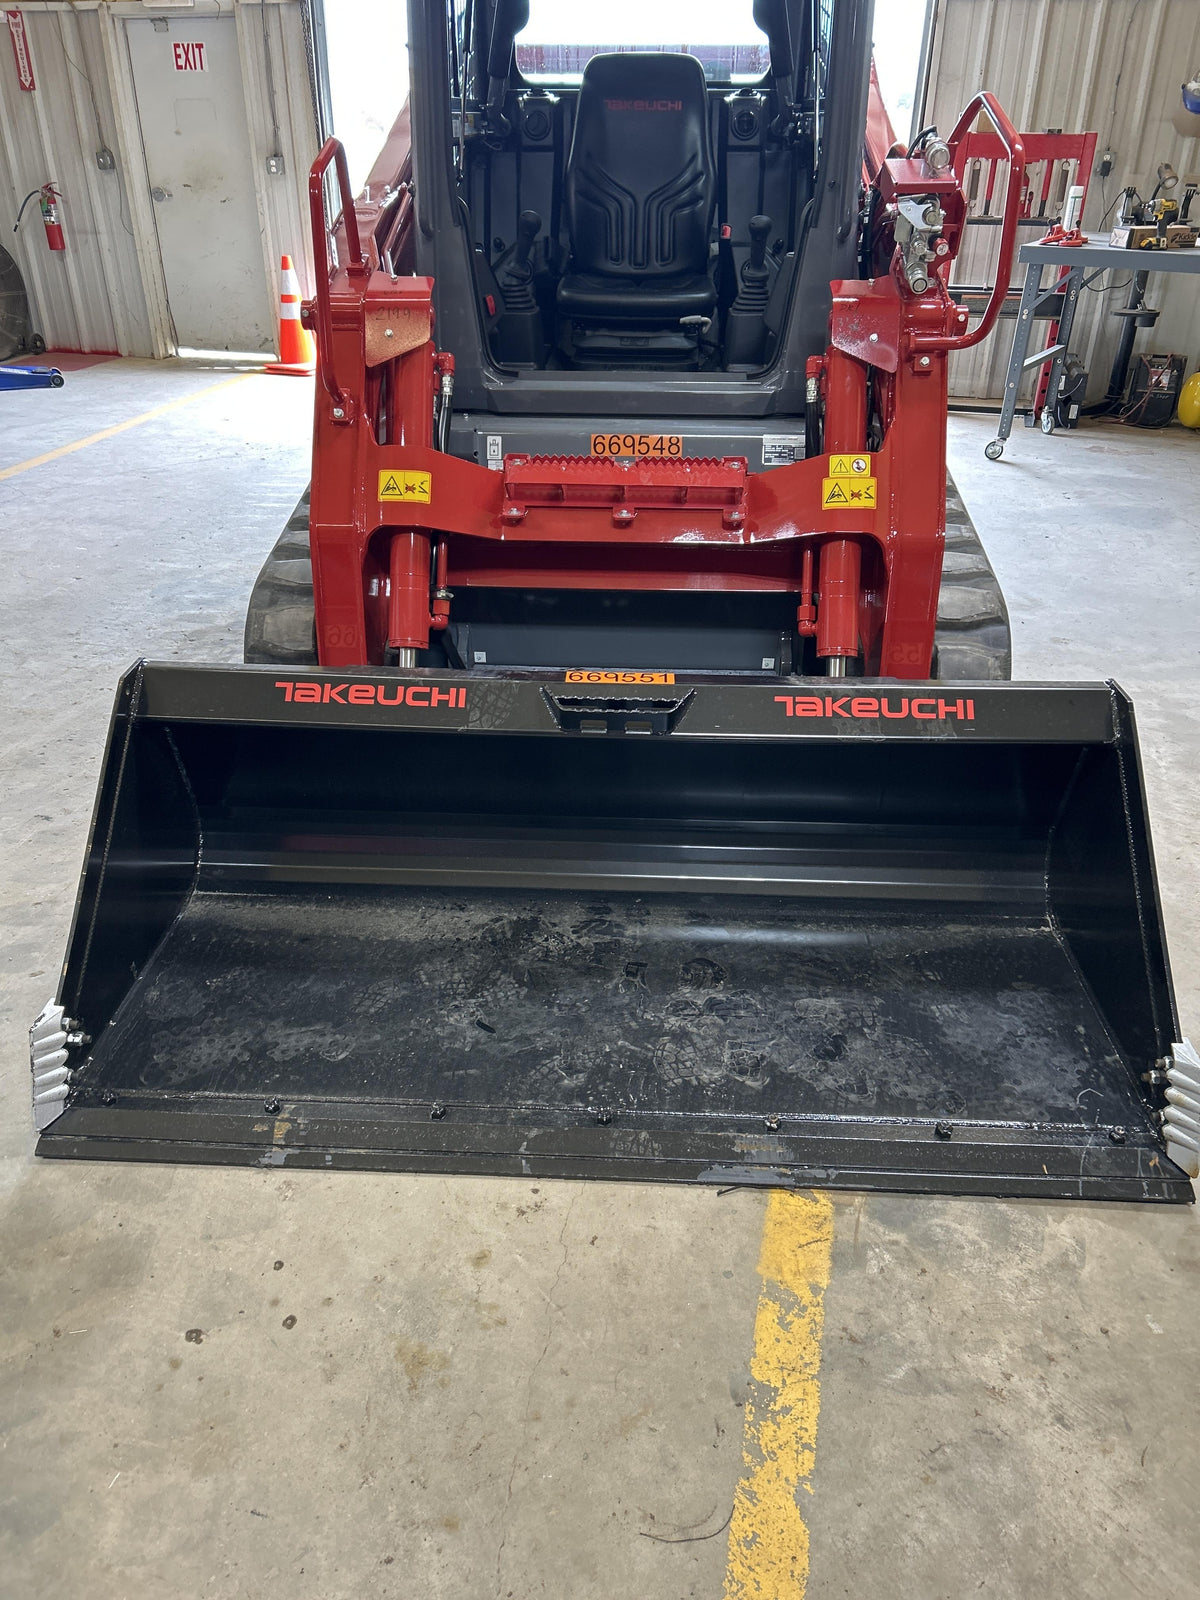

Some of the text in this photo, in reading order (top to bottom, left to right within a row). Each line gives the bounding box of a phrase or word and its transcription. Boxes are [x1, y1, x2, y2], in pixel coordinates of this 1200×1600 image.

[173, 43, 204, 70] EXIT
[593, 434, 681, 455] 669548
[568, 672, 669, 683] 669551
[275, 682, 467, 708] TAKEUCHI
[774, 696, 975, 720] TAKEUCHI
